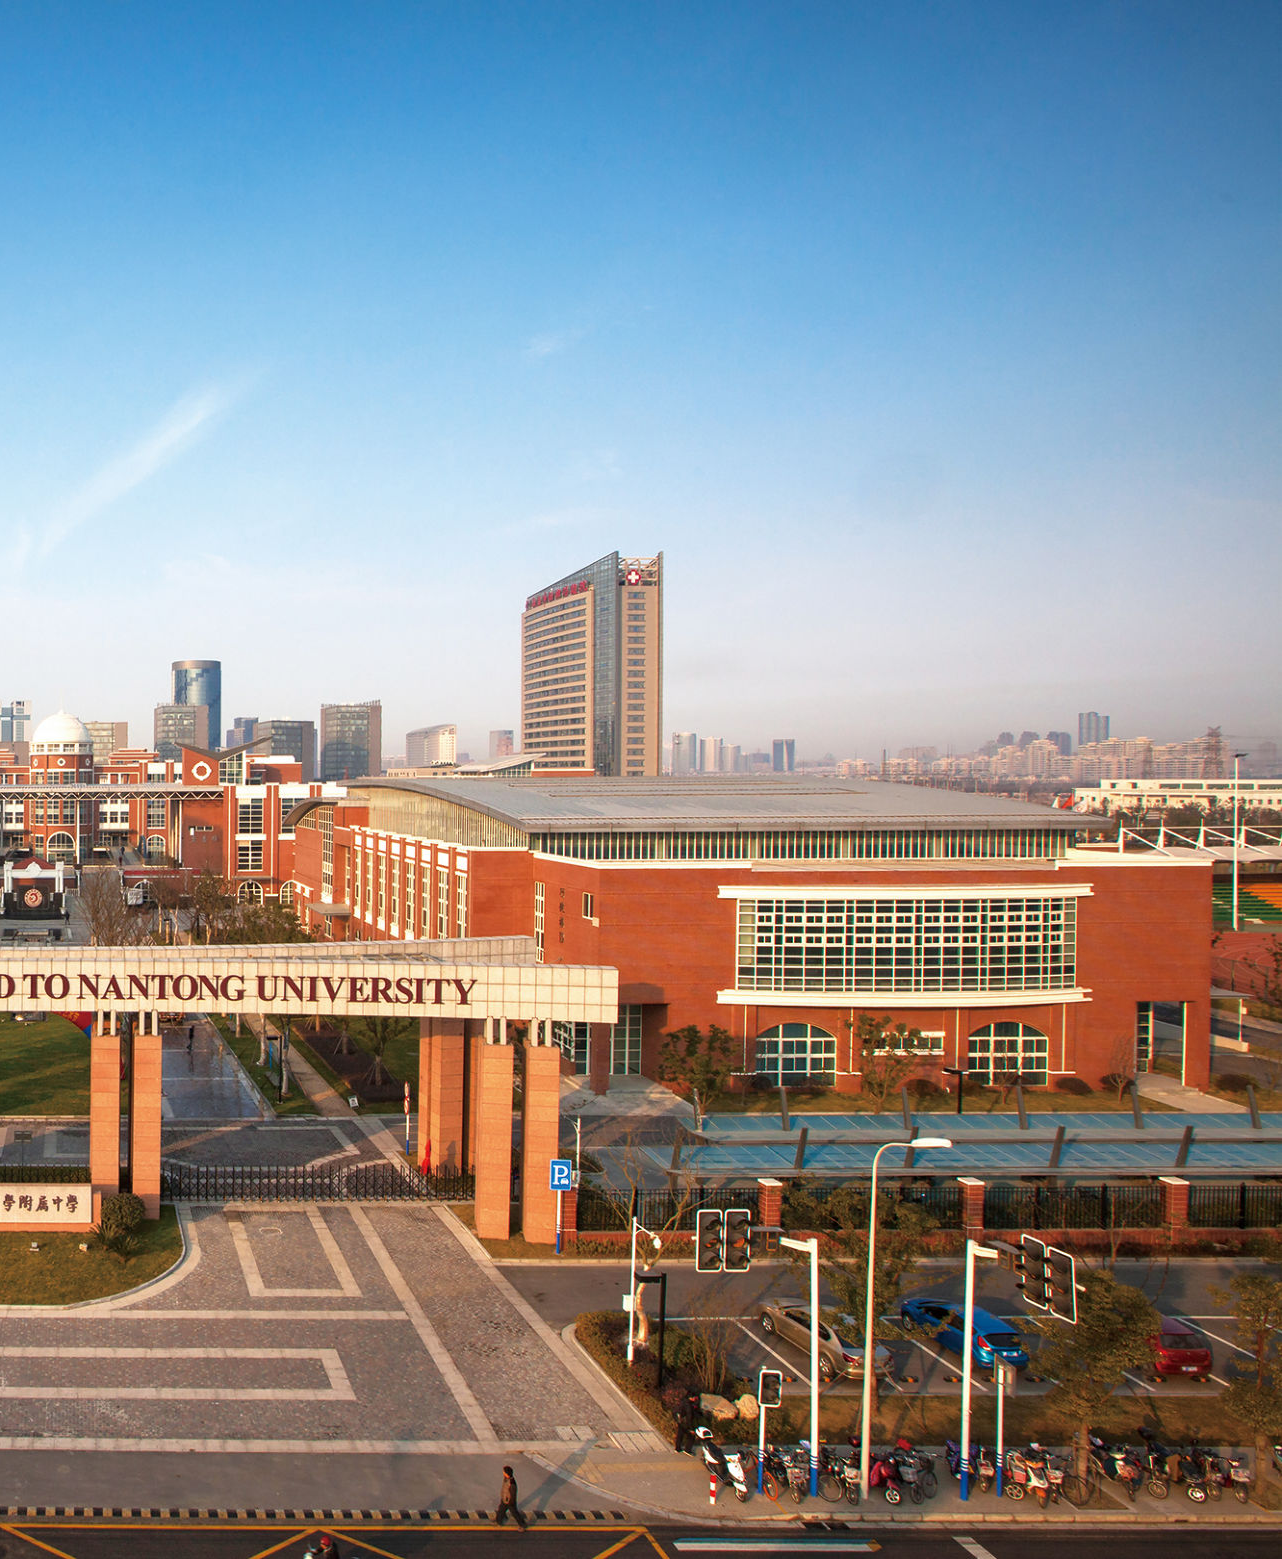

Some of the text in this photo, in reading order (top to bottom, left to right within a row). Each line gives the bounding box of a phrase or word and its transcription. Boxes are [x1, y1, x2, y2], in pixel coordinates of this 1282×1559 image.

[22, 974, 70, 1000] TO
[76, 974, 247, 1001] NANTONG
[255, 975, 478, 1006] UNIVERSITY
[552, 1164, 569, 1186] P
